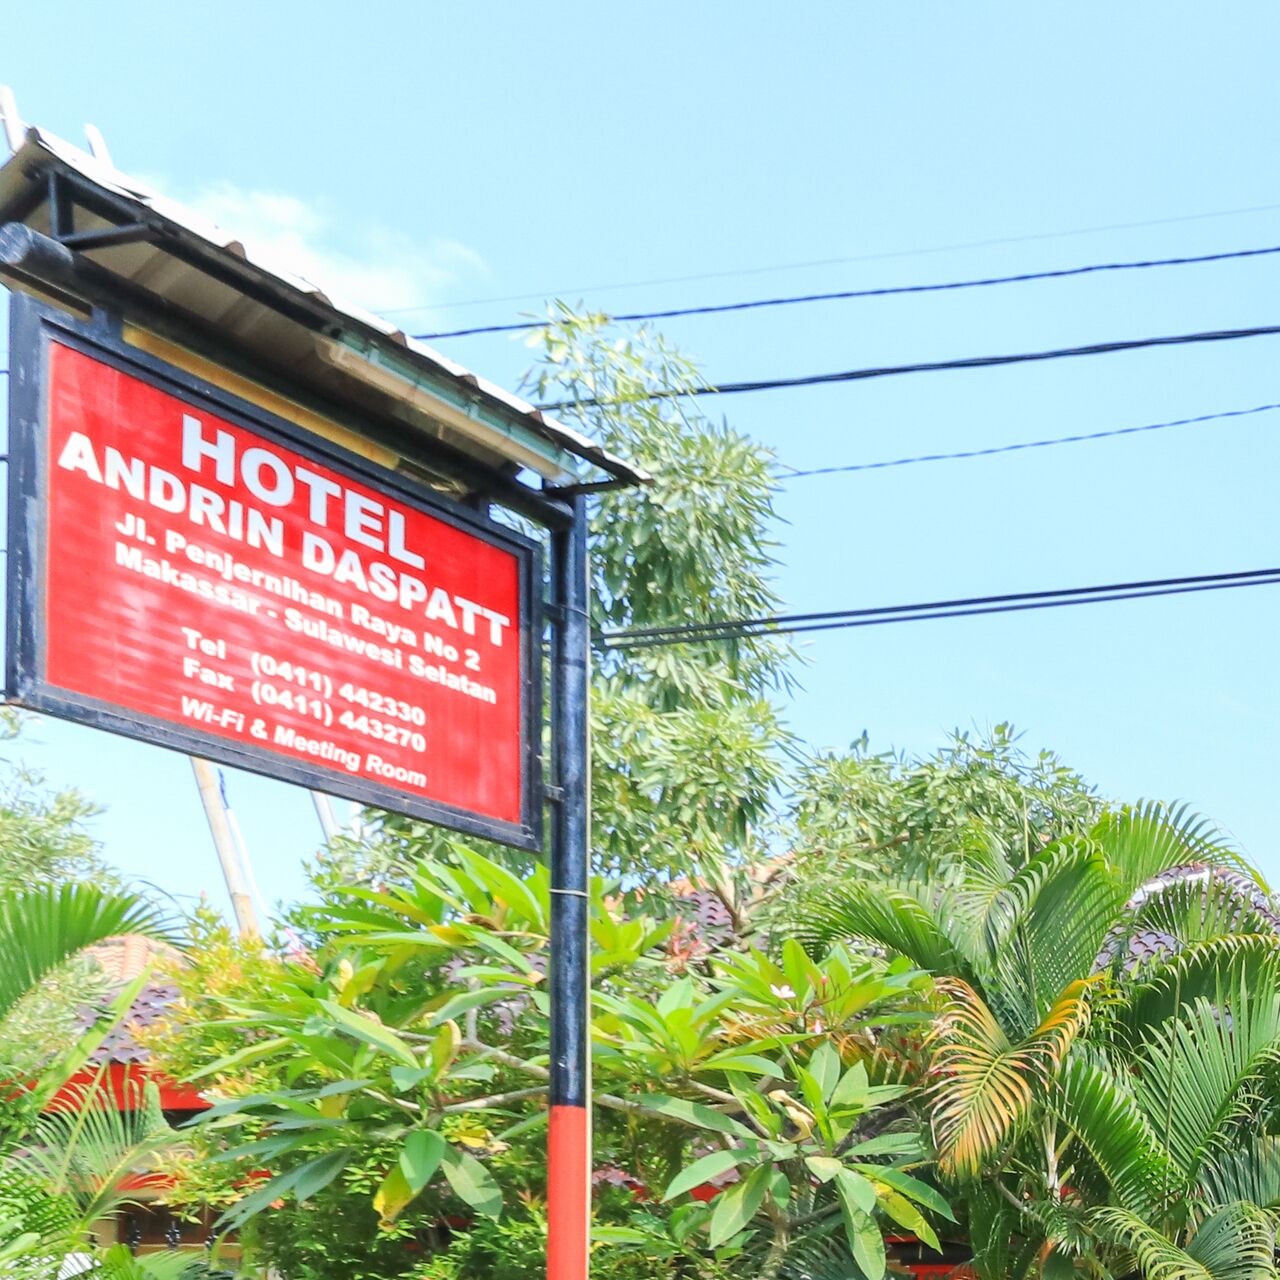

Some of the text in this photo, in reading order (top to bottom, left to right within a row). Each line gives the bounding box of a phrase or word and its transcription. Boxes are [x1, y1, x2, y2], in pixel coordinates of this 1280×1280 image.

[58, 431, 510, 647] ANDRIN DASPATT
[182, 414, 425, 570] HOTEL
[115, 513, 481, 671] Jl. Penjernihan Raya No 2
[115, 541, 261, 616] Makassar
[284, 607, 403, 670] Sulawesi
[408, 654, 497, 705] Selatan
[181, 626, 426, 726] Tel (0411) 442330
[181, 695, 427, 788] Wi-Fi & Meeting Room
[183, 656, 426, 753] Fax (0411) 443270
